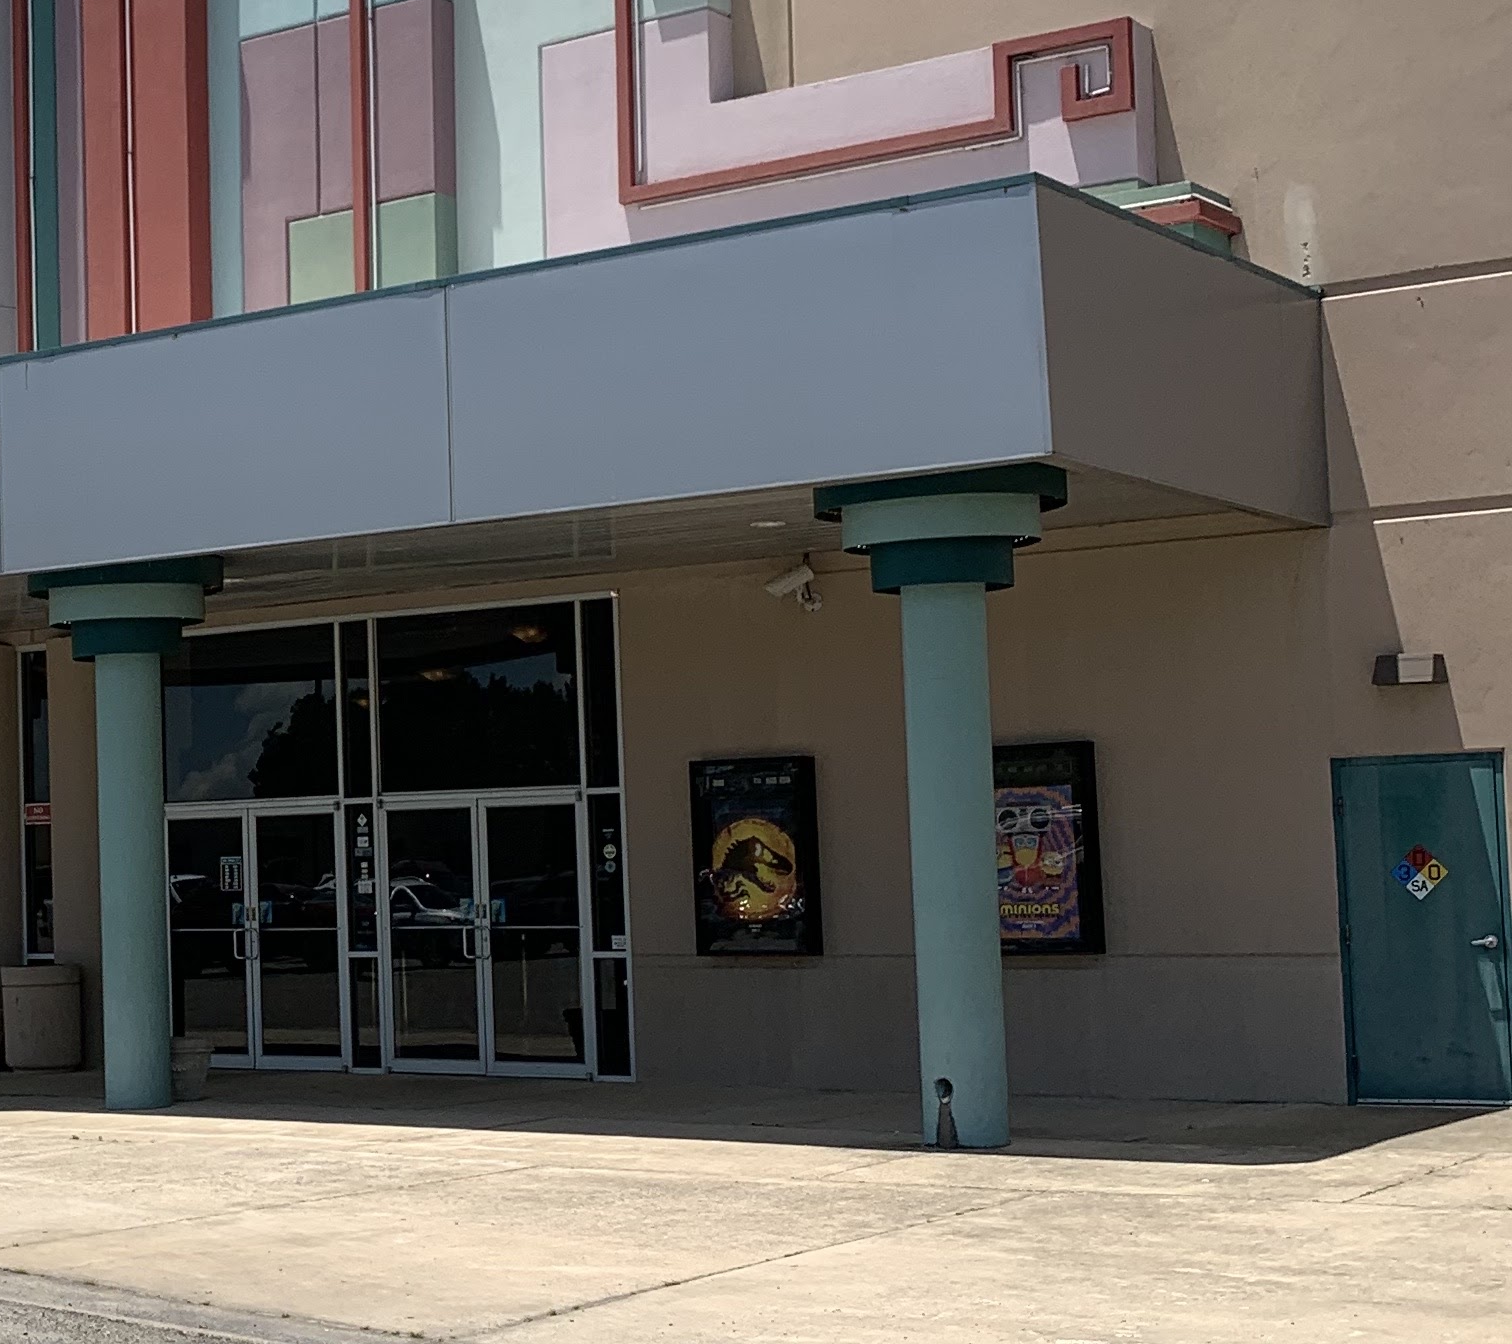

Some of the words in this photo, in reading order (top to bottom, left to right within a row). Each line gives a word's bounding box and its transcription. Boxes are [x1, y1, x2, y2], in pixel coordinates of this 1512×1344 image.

[1412, 849, 1426, 866] 0
[1397, 864, 1411, 880] 3
[1428, 864, 1441, 880] 0
[1411, 880, 1428, 892] SA
